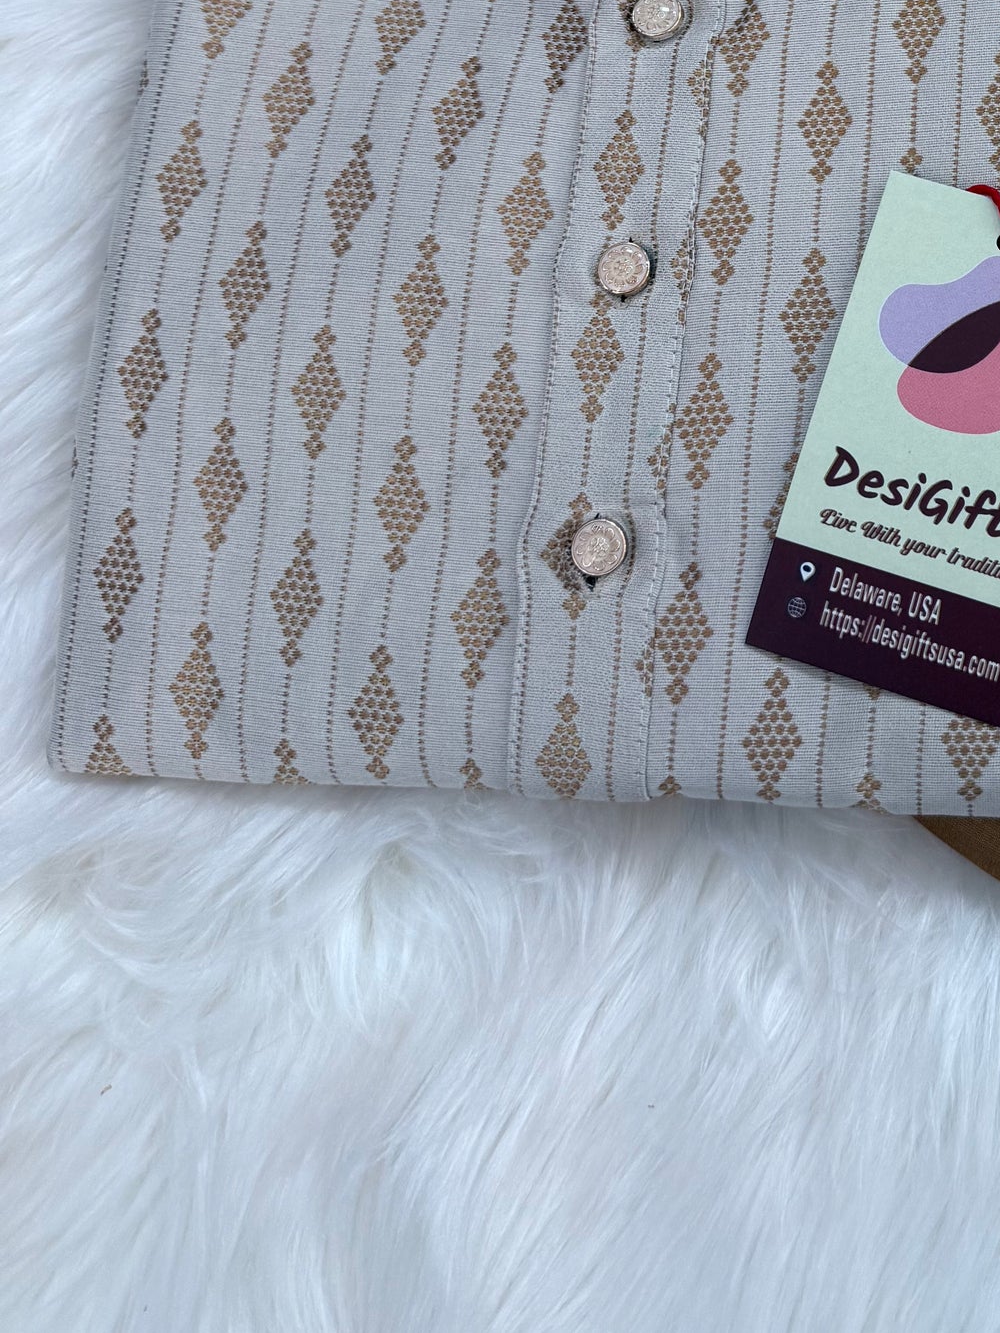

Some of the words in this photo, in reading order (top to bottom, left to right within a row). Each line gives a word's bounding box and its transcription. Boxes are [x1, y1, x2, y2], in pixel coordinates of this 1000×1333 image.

[819, 508, 858, 534] Live
[860, 520, 902, 548] With
[899, 535, 948, 557] your
[828, 566, 904, 617] Delaware,
[907, 590, 943, 626] USA
